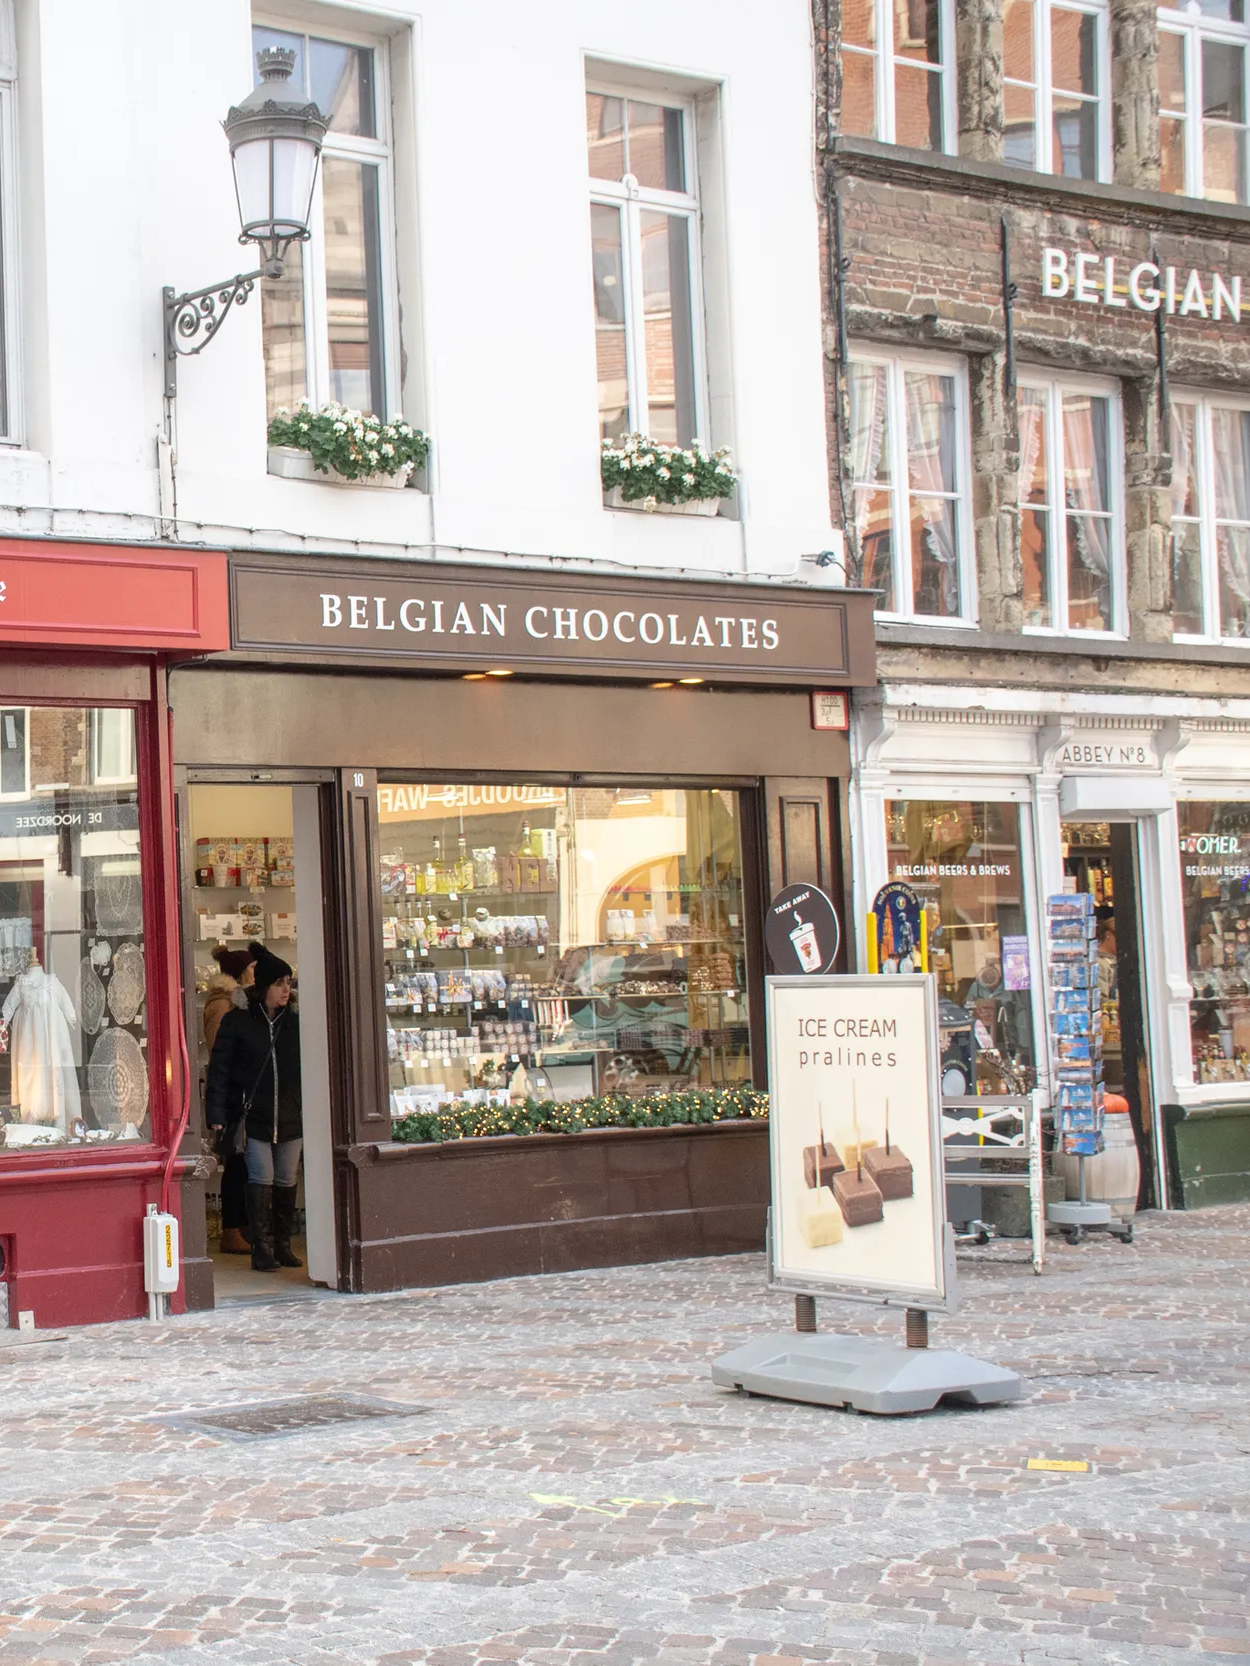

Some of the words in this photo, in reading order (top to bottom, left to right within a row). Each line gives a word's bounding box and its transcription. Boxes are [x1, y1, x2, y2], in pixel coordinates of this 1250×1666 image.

[1042, 248, 1241, 323] BELGIAN
[319, 593, 507, 636] BELGIAN
[524, 606, 780, 650] CHOCOLATES
[1062, 746, 1113, 762] ABBEY
[353, 772, 364, 788] 10
[896, 865, 937, 876] BELGIAN
[938, 865, 967, 876] BEERS
[969, 865, 977, 876] &
[978, 865, 1010, 876] BREWS
[1185, 865, 1223, 876] BELGIAN
[774, 901, 792, 914] TAKE
[792, 891, 810, 905] AWAY
[798, 1018, 827, 1037] ICE
[833, 1018, 897, 1038] CREAM
[799, 1047, 897, 1069] pralines
